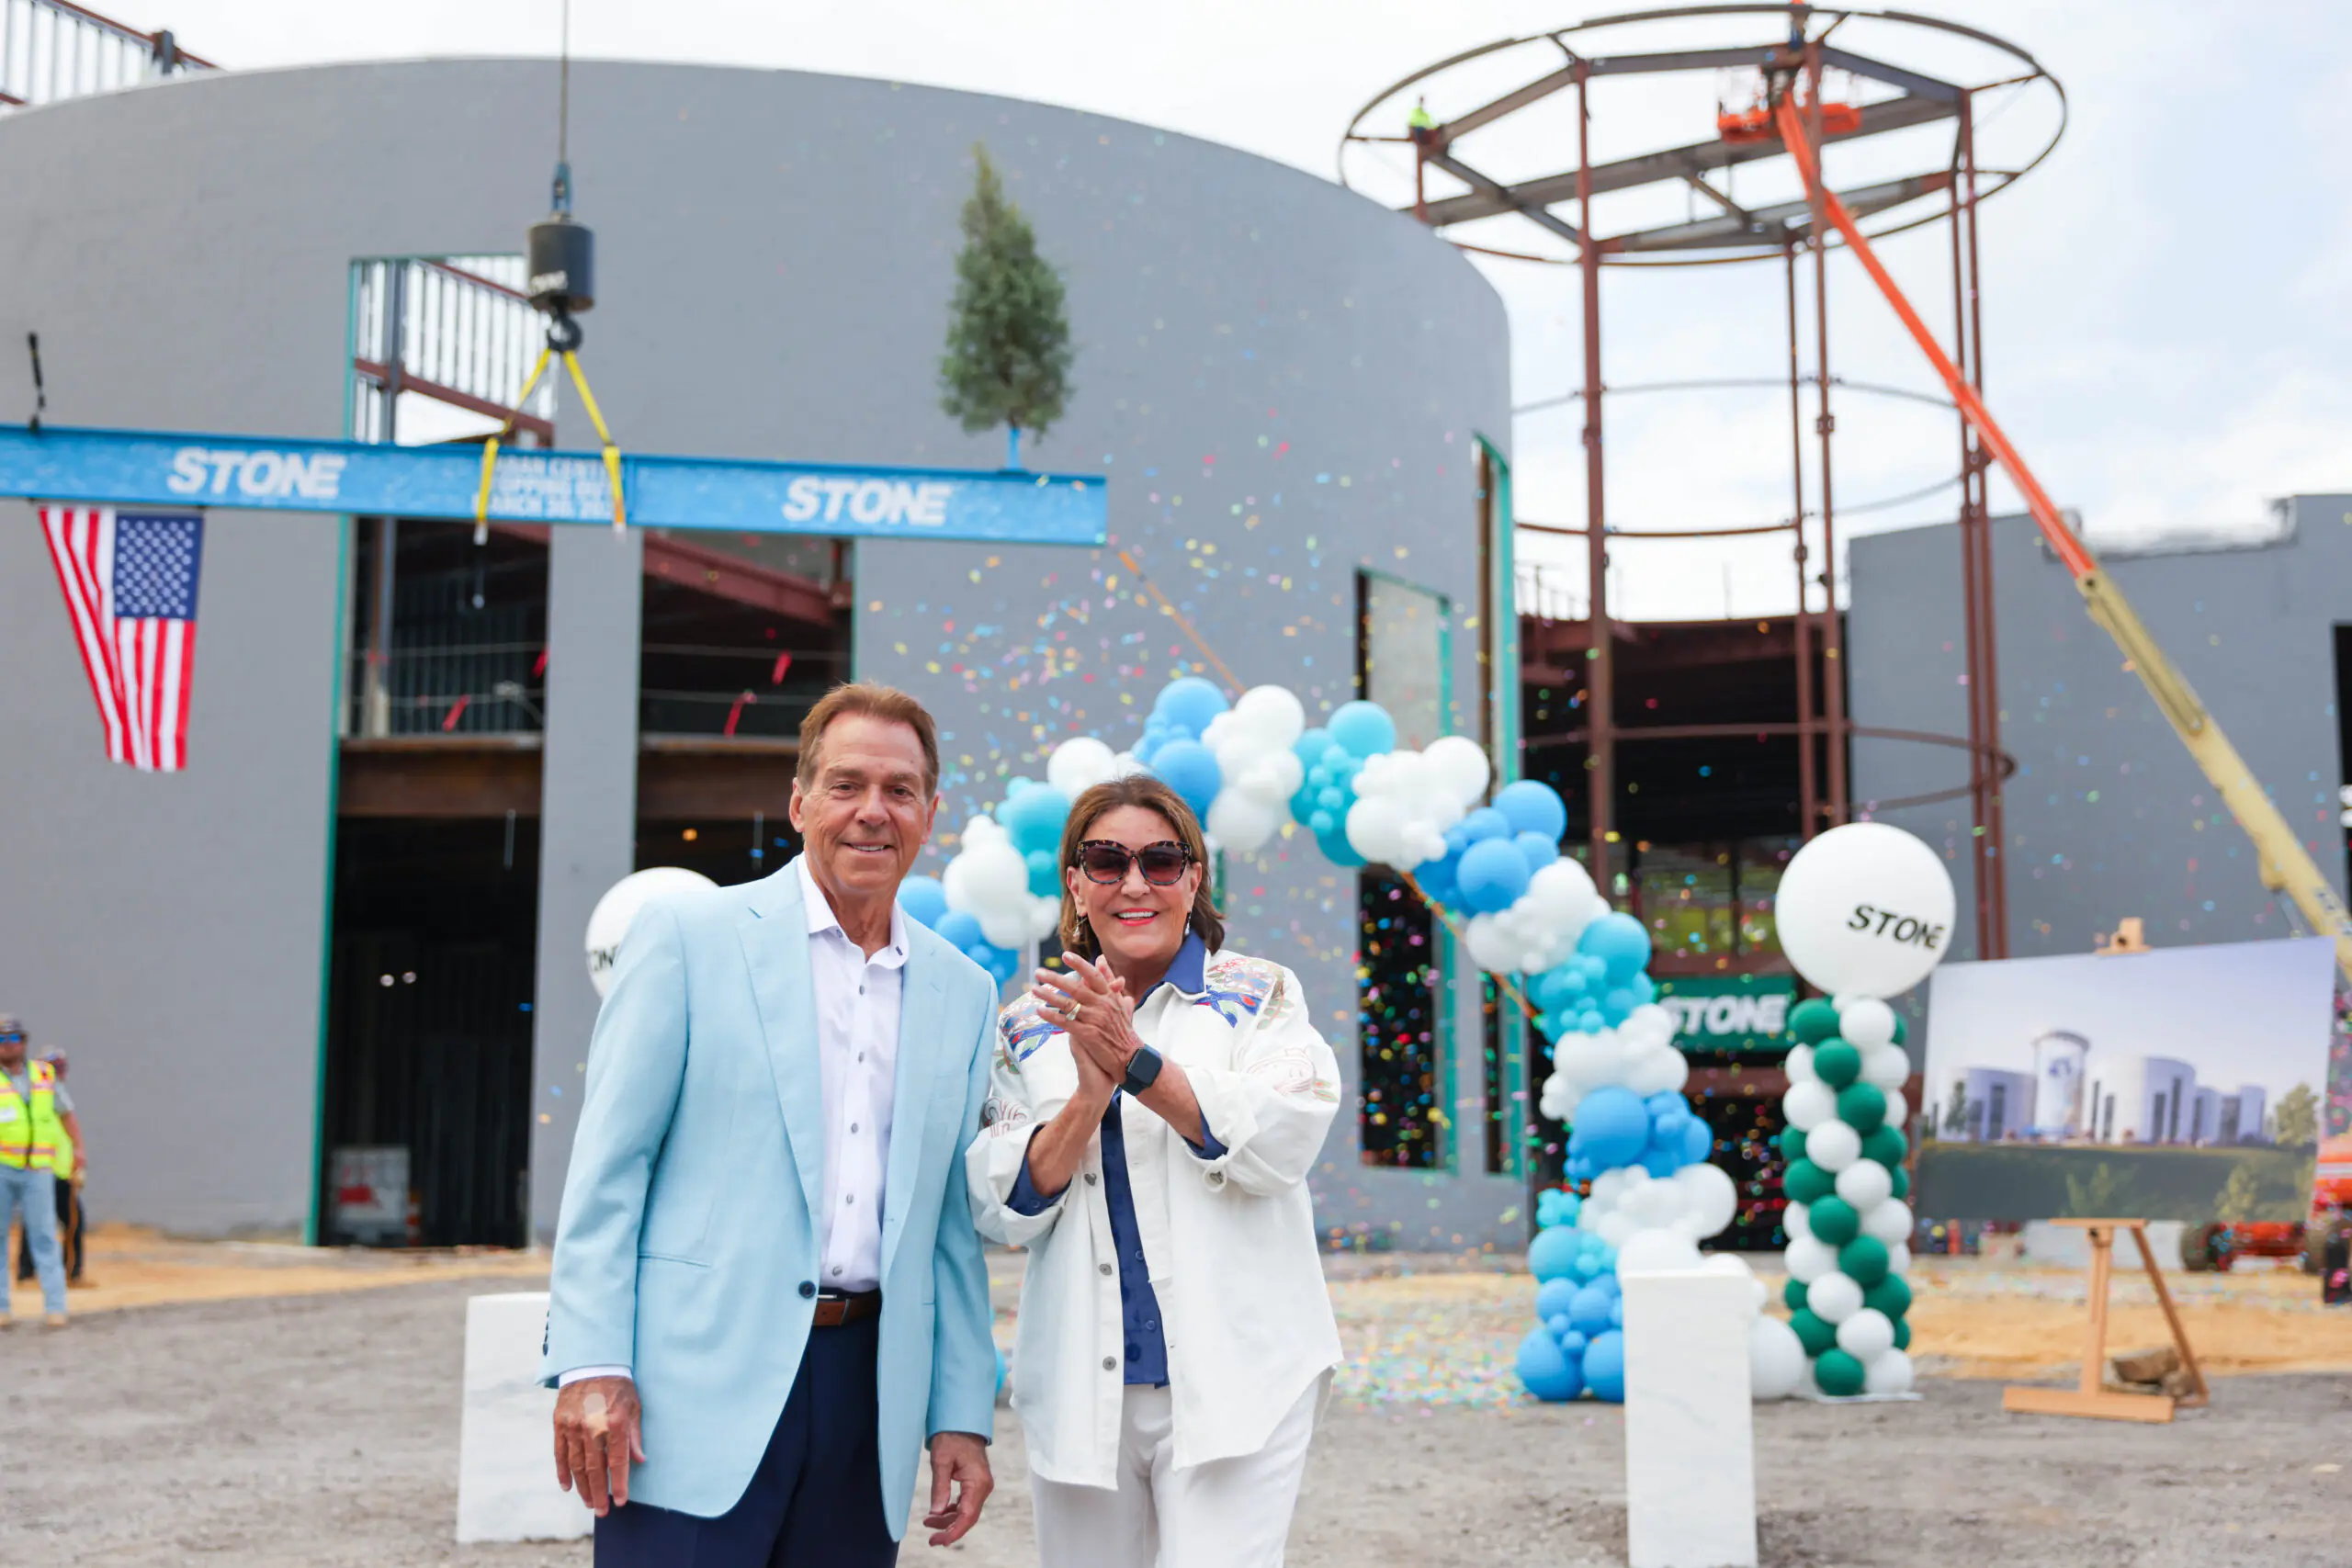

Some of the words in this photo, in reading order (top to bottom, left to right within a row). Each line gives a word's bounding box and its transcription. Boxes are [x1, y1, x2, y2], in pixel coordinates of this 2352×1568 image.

[166, 446, 346, 499] STONE
[783, 476, 953, 526] STONE
[1848, 904, 1944, 950] STONE
